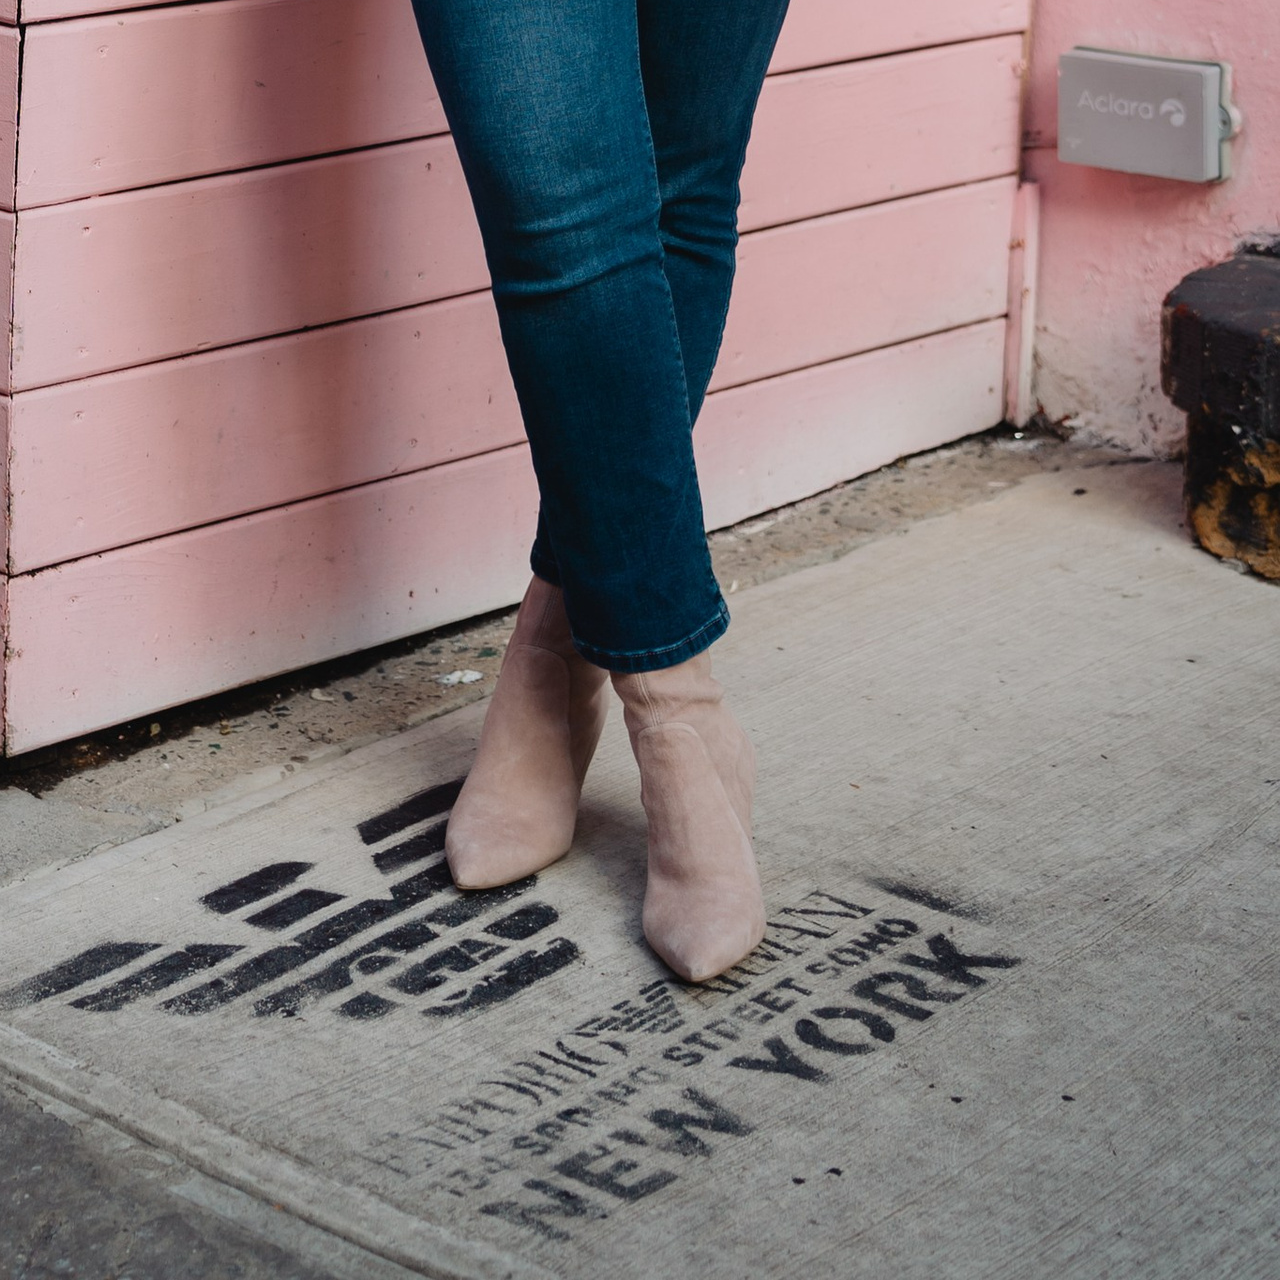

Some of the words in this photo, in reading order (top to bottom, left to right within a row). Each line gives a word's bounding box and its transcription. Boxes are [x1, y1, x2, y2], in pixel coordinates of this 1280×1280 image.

[1076, 90, 1155, 121] Aclara
[661, 976, 812, 1067] STREET
[803, 916, 921, 981] SOHO
[477, 1085, 756, 1241] NEW
[726, 932, 1023, 1083] YORK
